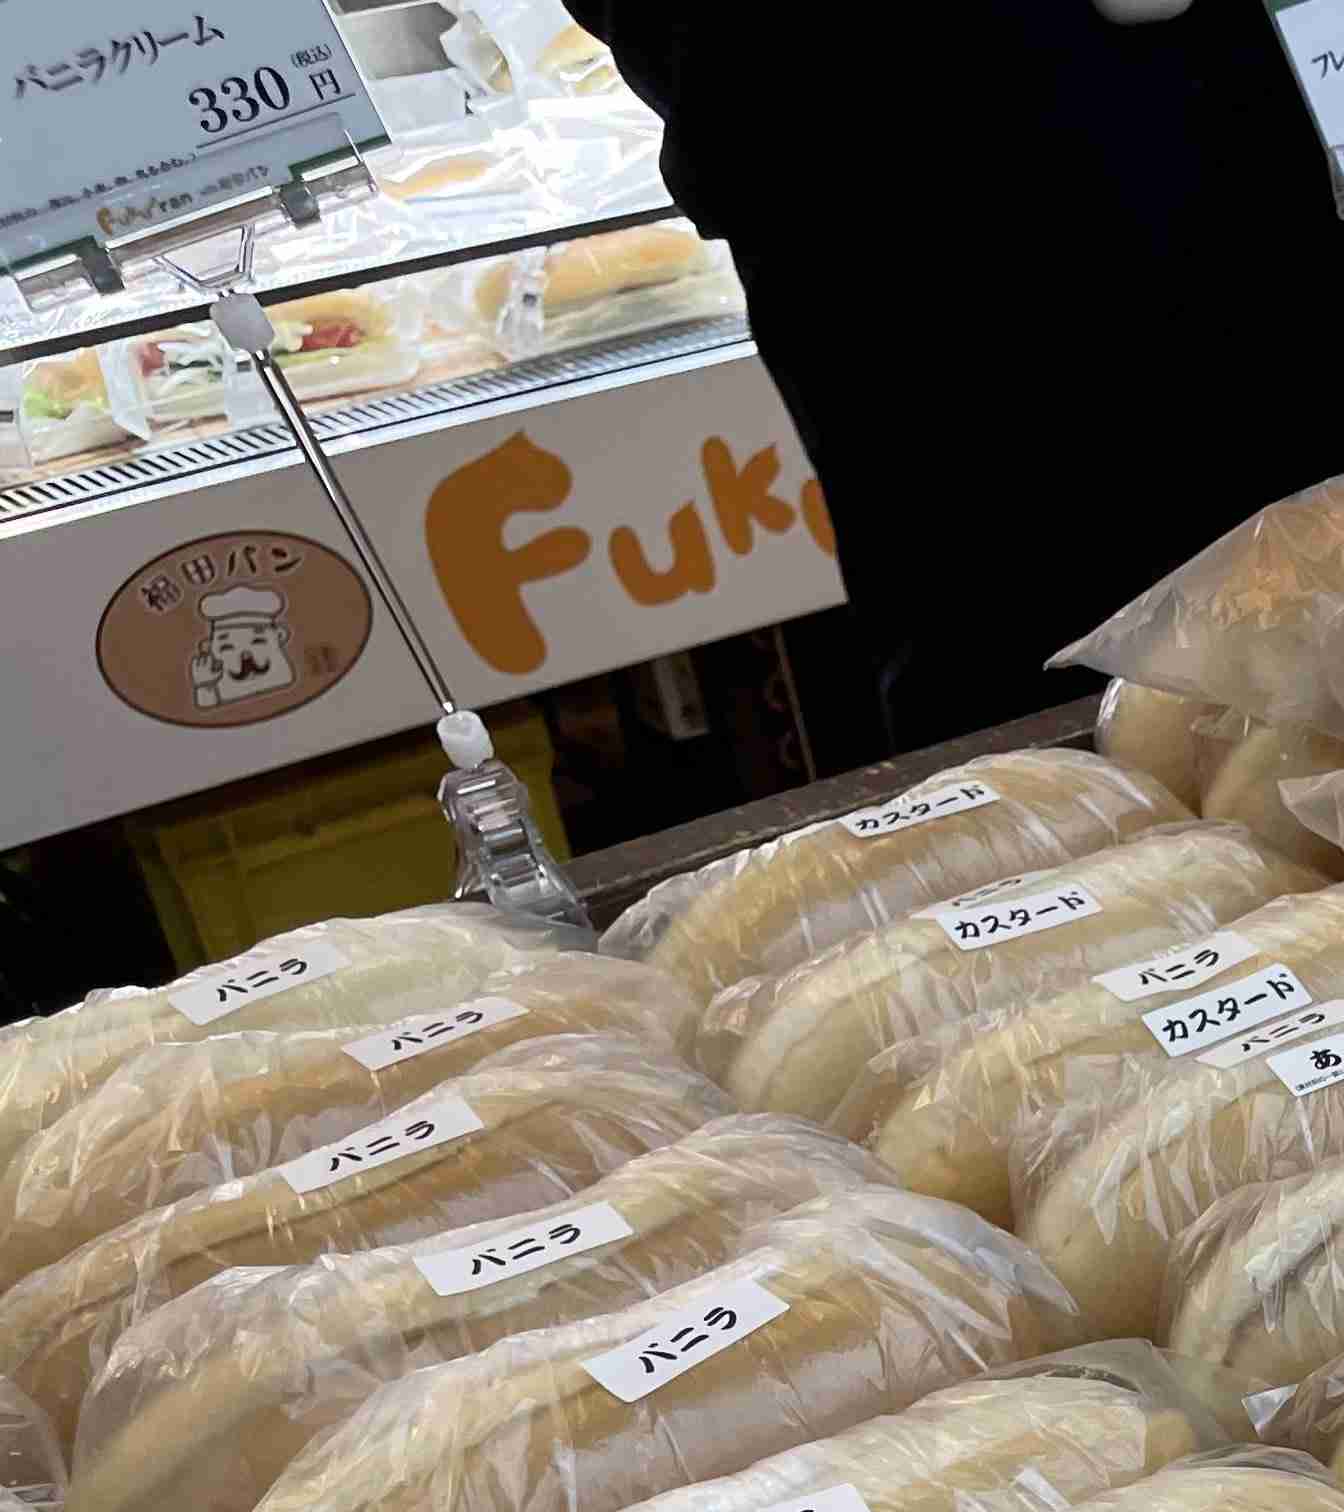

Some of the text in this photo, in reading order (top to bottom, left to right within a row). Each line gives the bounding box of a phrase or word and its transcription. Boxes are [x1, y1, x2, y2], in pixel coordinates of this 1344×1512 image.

[15, 15, 225, 97] バニラクリーム
[188, 66, 291, 133] 330
[309, 68, 341, 100] 円
[141, 545, 303, 613] 福田パン
[855, 784, 985, 832] カスタード
[955, 890, 1086, 940] カスタード
[217, 958, 307, 1002] バニラ
[1139, 949, 1219, 985] バニラ
[391, 1011, 483, 1051] バニラ
[1162, 973, 1296, 1043] カスタード
[1240, 1013, 1326, 1052] バニラ
[330, 1120, 435, 1172] バニラ
[470, 1222, 583, 1276] バニラ
[638, 1306, 737, 1377] バニラ
